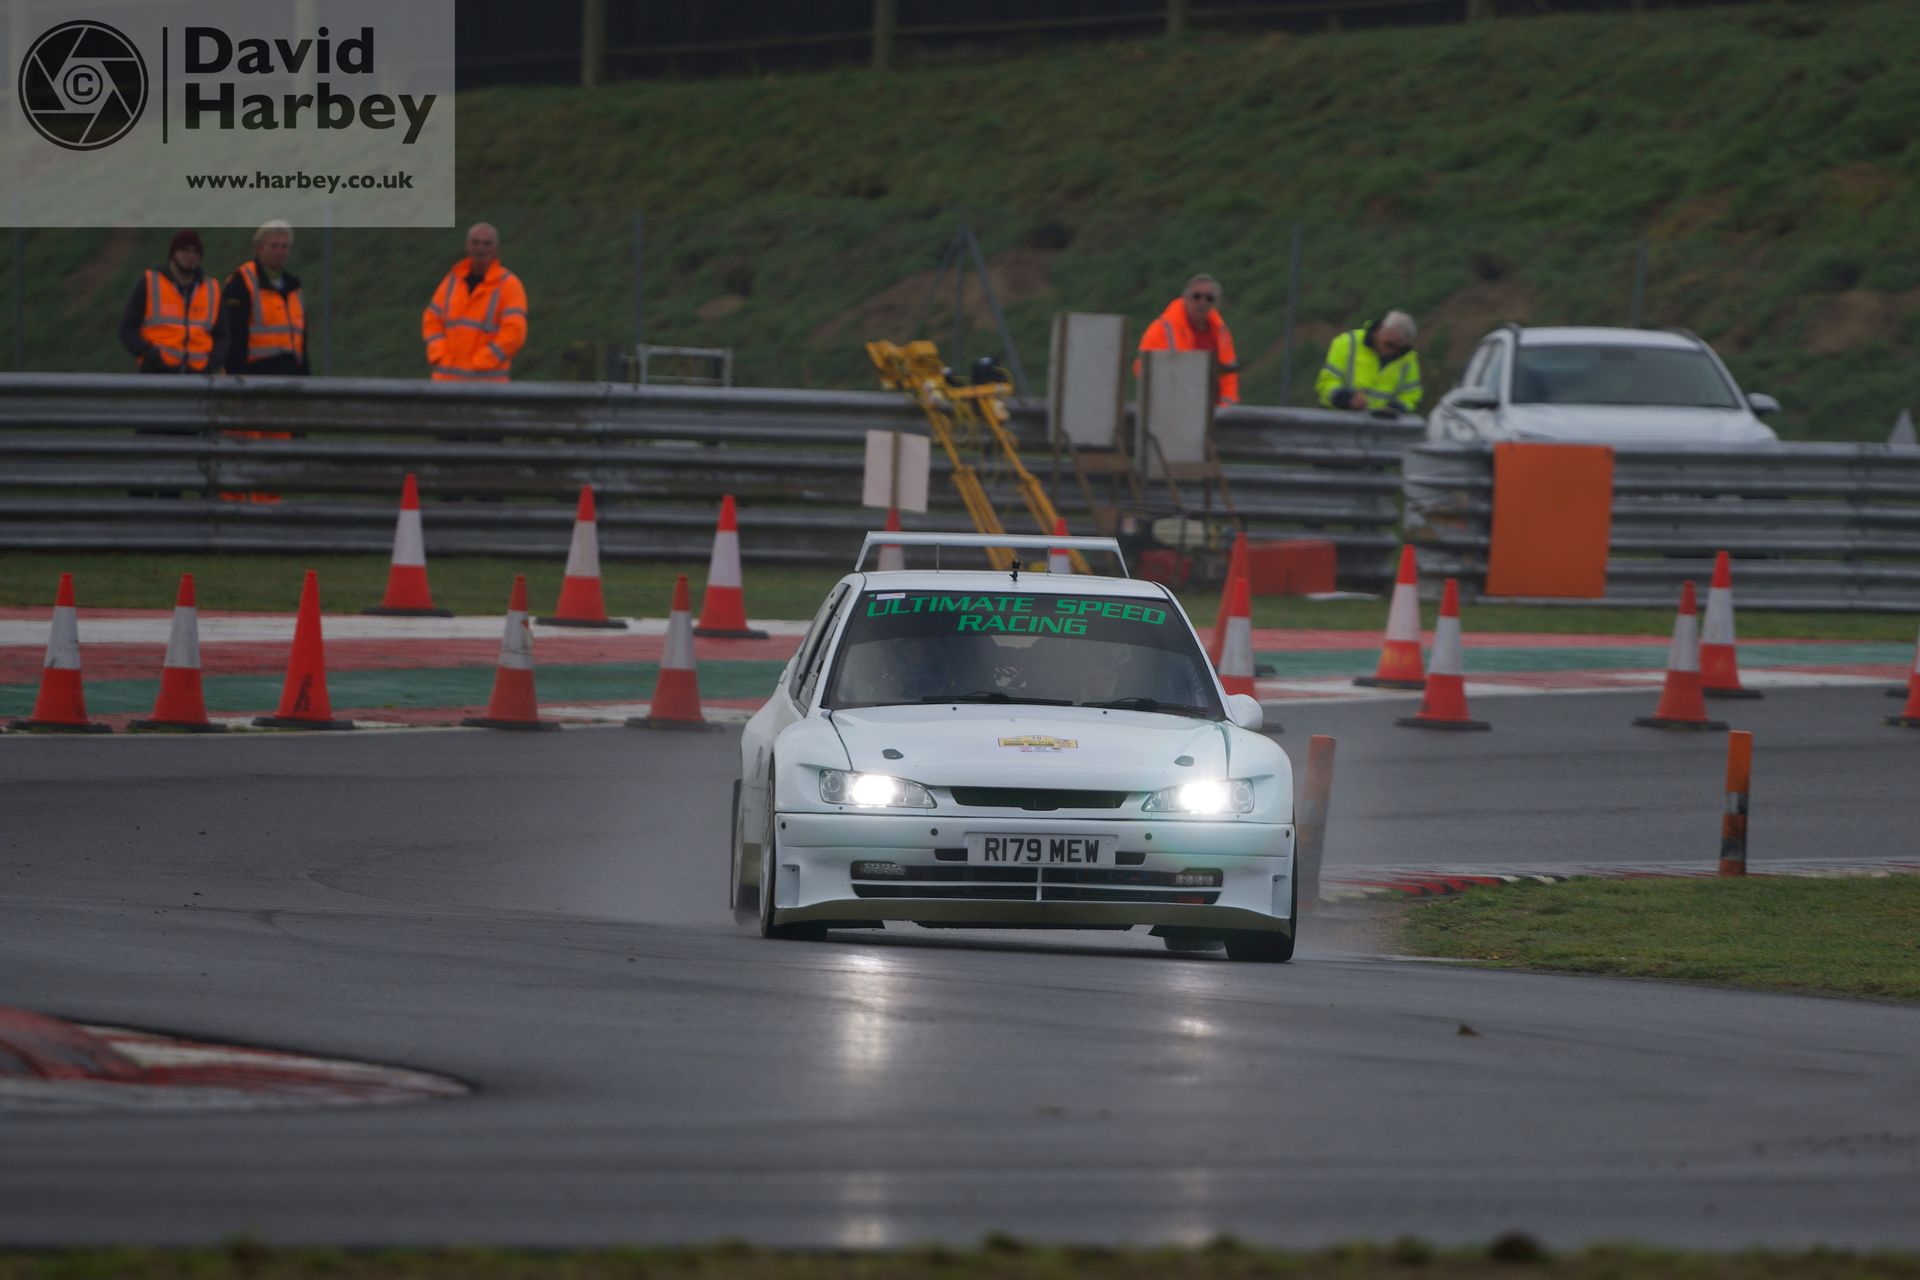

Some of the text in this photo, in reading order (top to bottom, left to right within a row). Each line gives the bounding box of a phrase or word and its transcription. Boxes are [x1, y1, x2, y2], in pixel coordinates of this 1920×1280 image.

[867, 596, 1167, 625] ULTIMATE SPEED
[957, 614, 1087, 635] RACING
[984, 838, 1100, 863] R179 MEW
